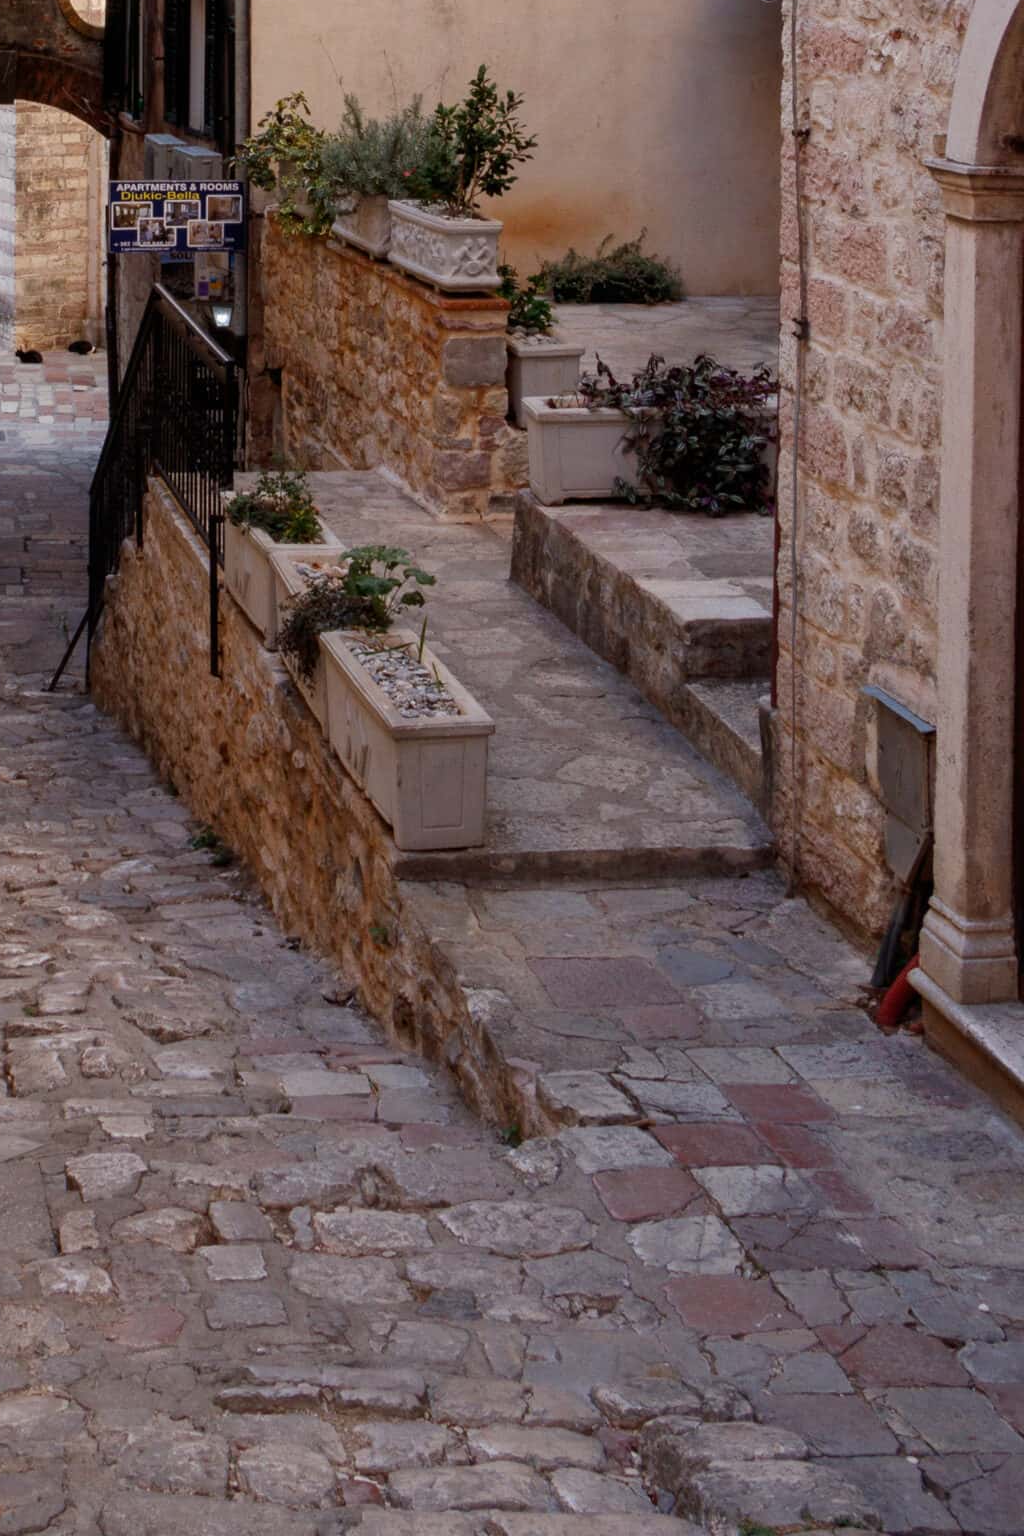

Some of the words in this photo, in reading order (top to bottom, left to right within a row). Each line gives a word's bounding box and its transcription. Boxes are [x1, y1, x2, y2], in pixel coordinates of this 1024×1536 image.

[116, 183, 187, 192] APARTMENTS
[189, 183, 197, 191] &
[200, 183, 239, 191] ROOMS
